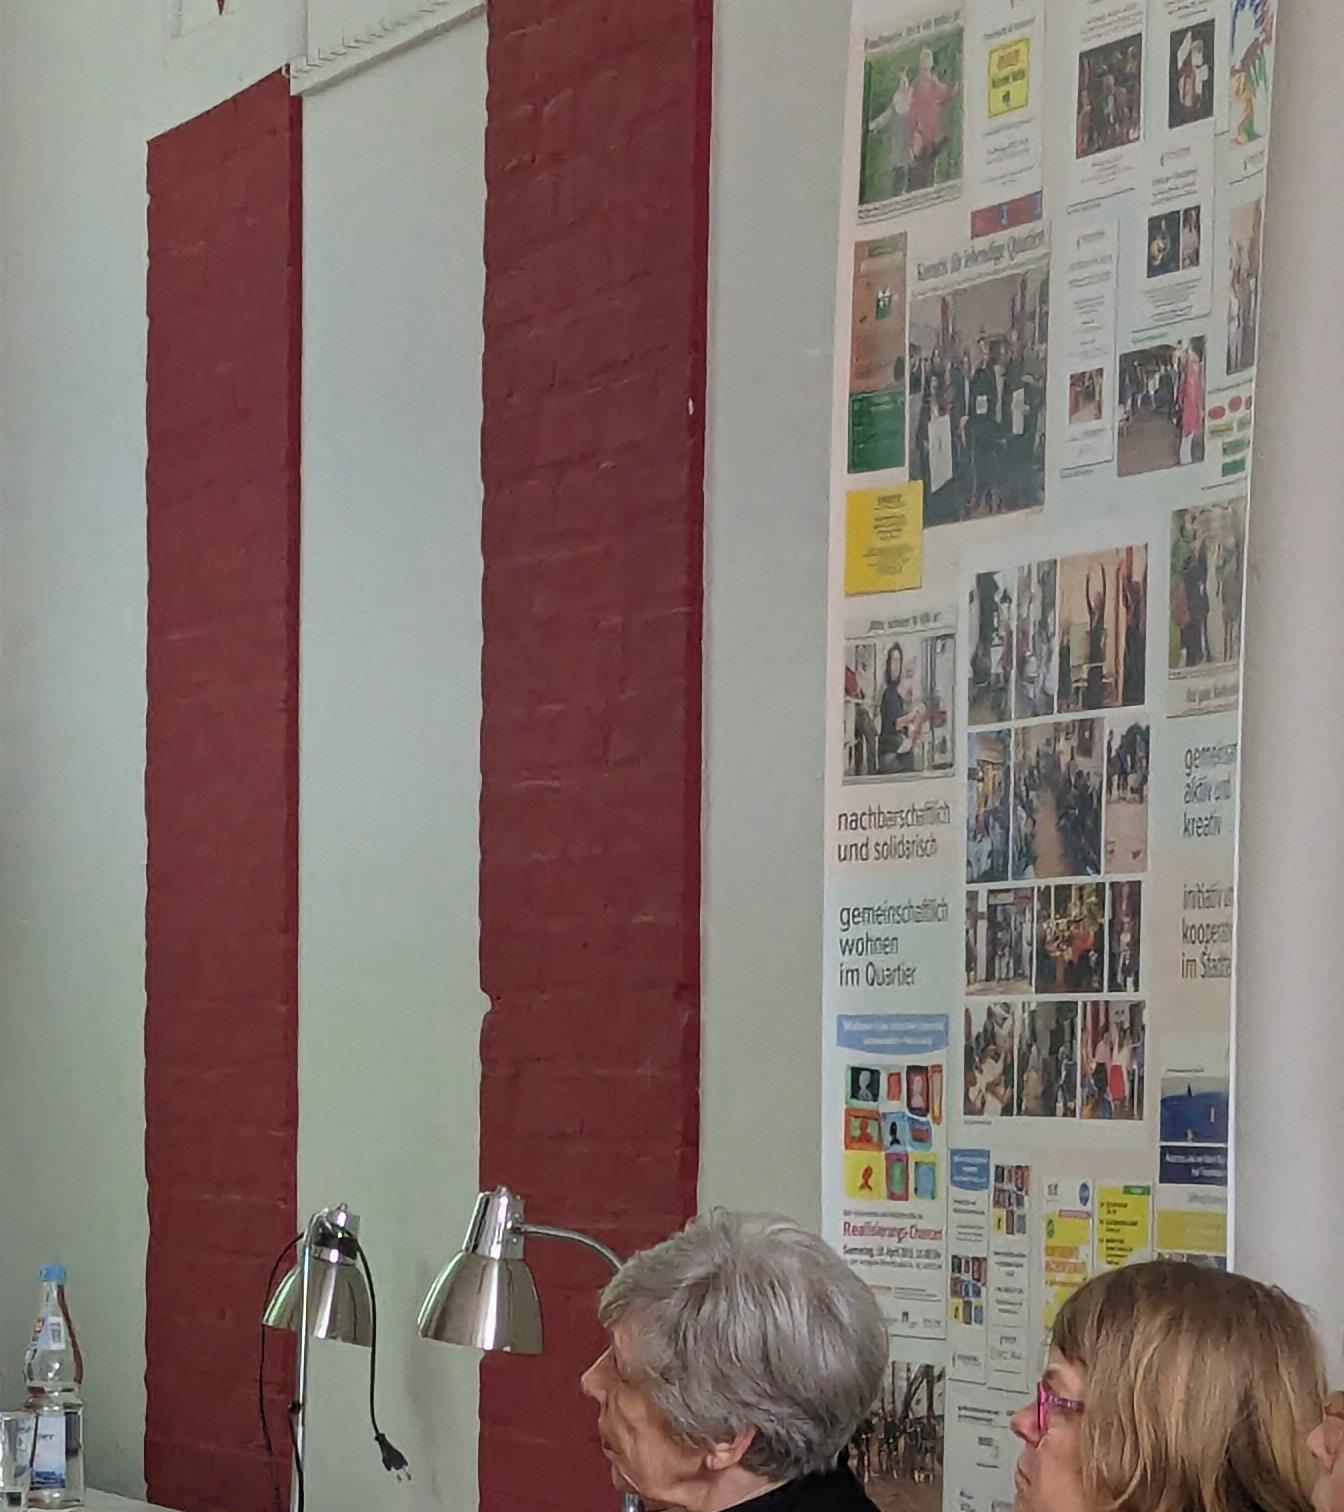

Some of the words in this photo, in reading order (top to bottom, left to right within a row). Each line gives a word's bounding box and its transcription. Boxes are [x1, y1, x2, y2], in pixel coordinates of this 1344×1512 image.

[837, 836, 870, 862] und
[873, 832, 938, 861] solidarisch
[839, 897, 949, 932] gemeinschaftlich
[839, 932, 899, 957] wohnen
[839, 963, 860, 987] im
[865, 961, 918, 987] Quartier
